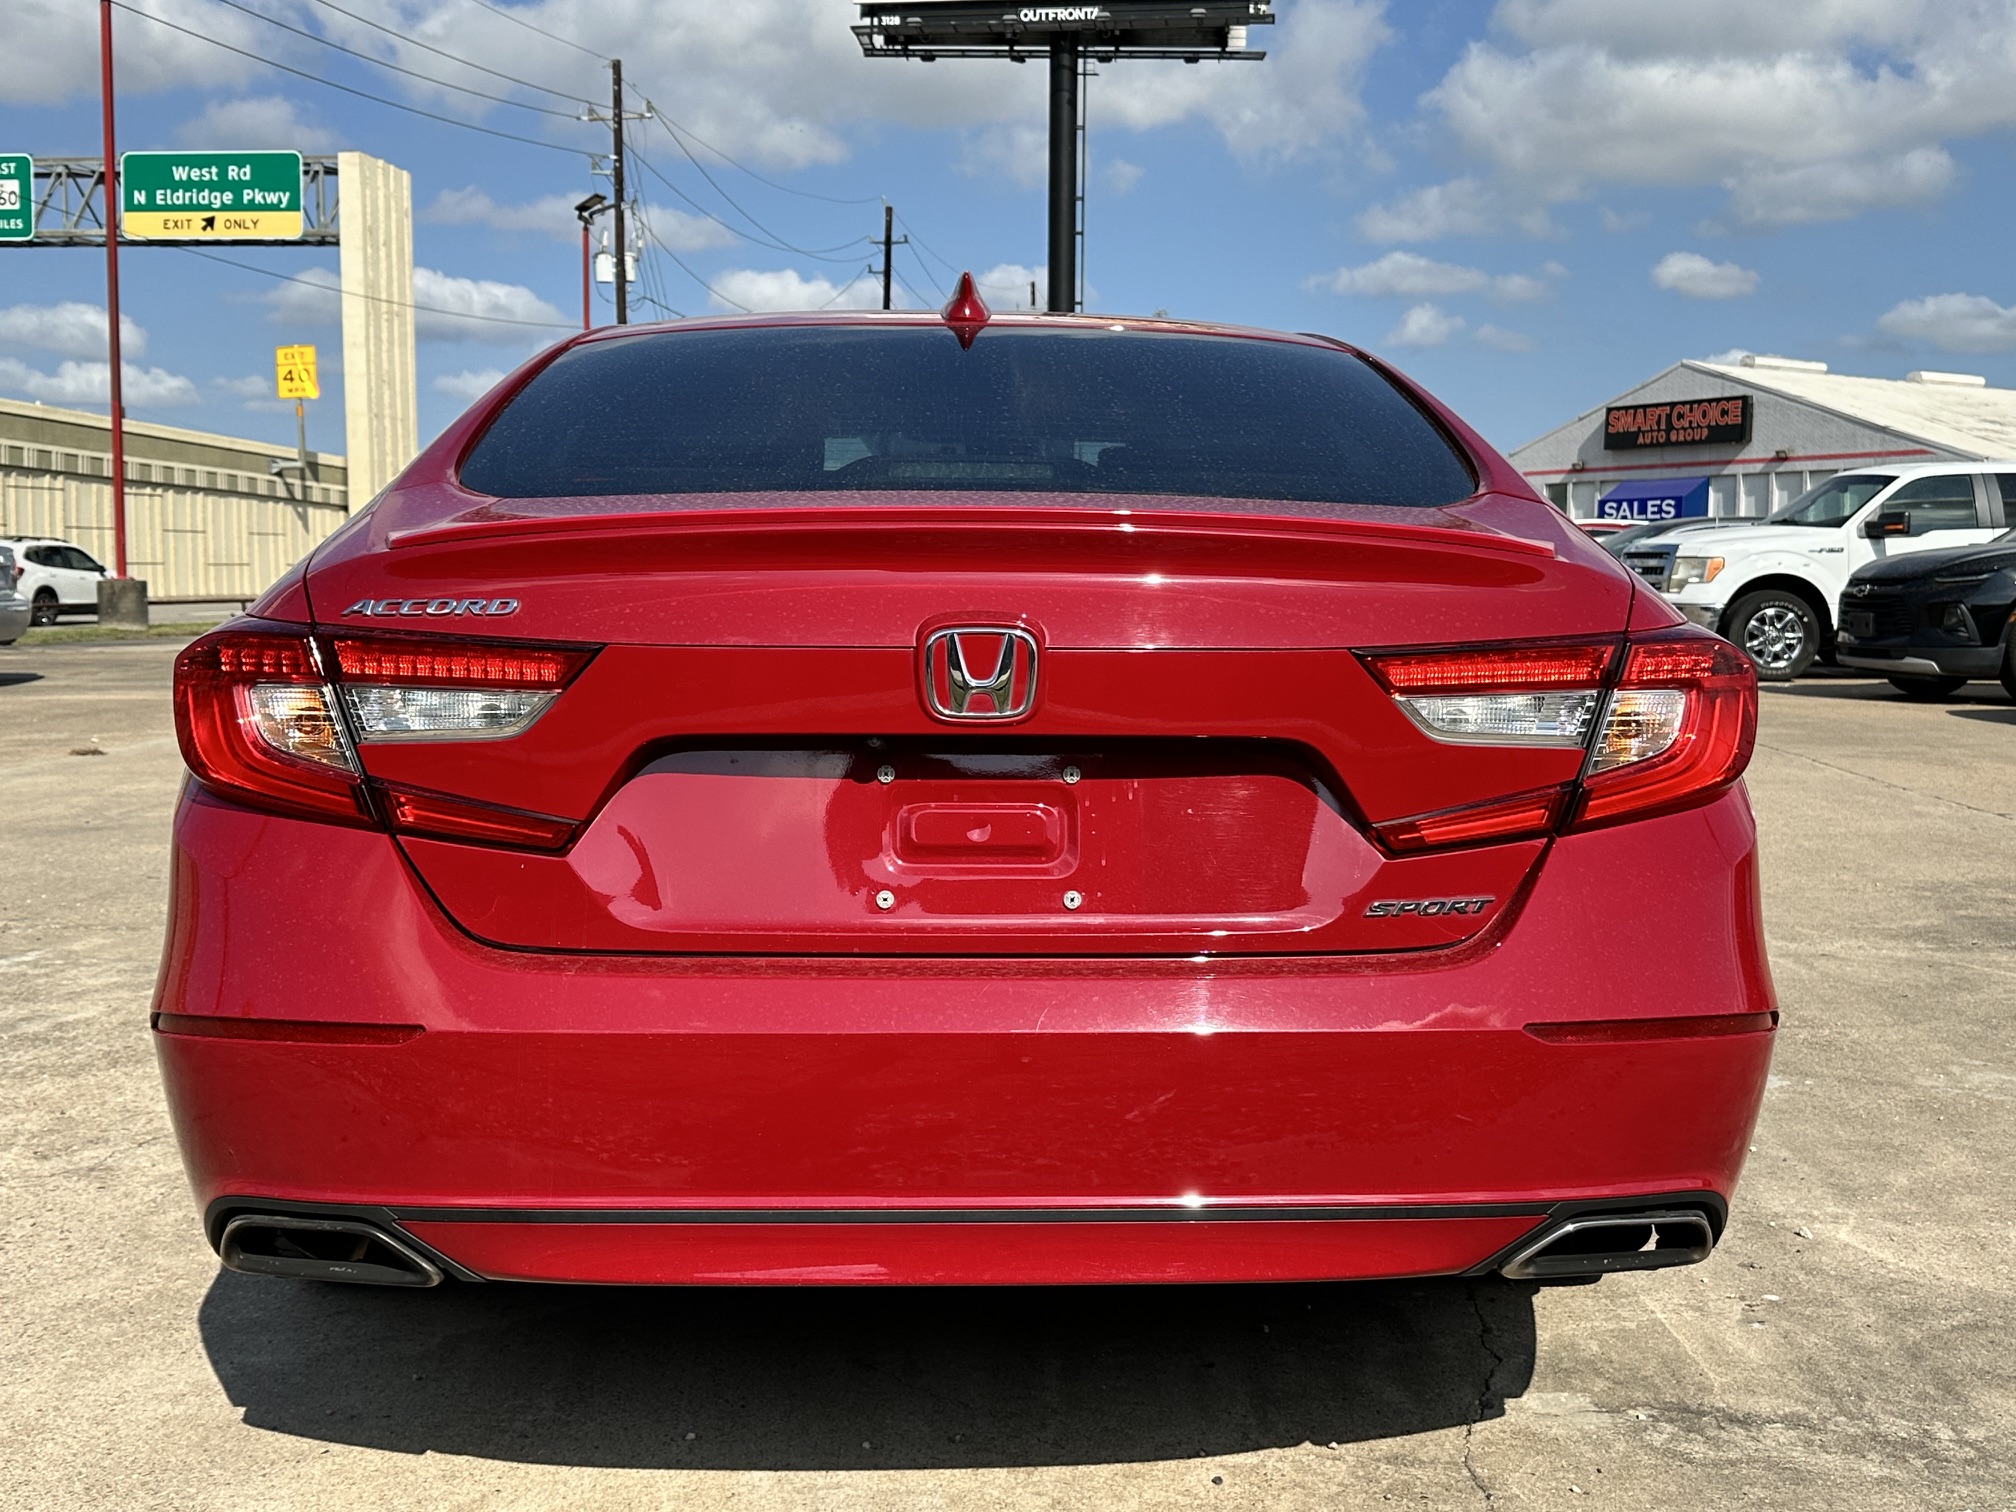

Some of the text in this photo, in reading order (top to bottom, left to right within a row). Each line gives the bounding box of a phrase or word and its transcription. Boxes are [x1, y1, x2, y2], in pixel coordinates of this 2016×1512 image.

[0, 162, 17, 175] ST
[172, 164, 251, 181] West Rd
[133, 188, 290, 209] N Eldridge Pkwy
[163, 218, 260, 230] EXIT ONLY
[283, 351, 305, 361] EXT
[283, 368, 311, 384] 40
[1608, 400, 1743, 434] SMART CHOICE
[1637, 427, 1709, 445] AUTO GROUP
[1604, 499, 1676, 520] SALES
[340, 598, 520, 617] ACCORD
[1363, 896, 1496, 918] SPORT
